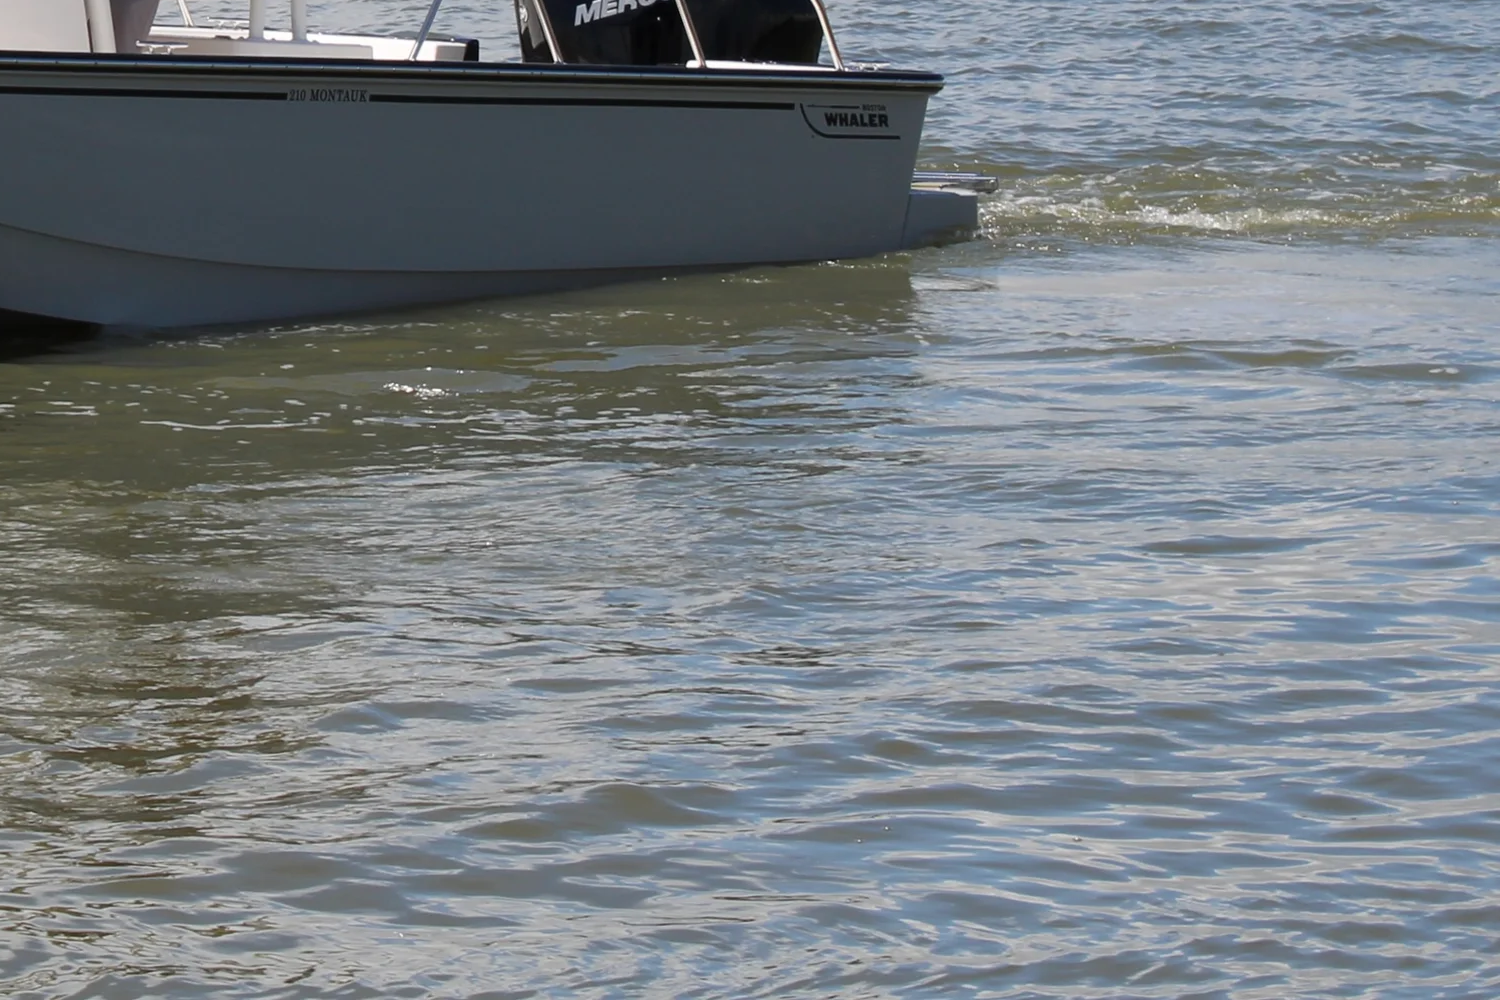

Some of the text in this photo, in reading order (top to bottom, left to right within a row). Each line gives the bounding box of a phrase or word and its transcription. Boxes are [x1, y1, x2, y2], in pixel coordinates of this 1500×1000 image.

[289, 88, 369, 103] 210 MONTAUK
[824, 112, 889, 128] WHALER
